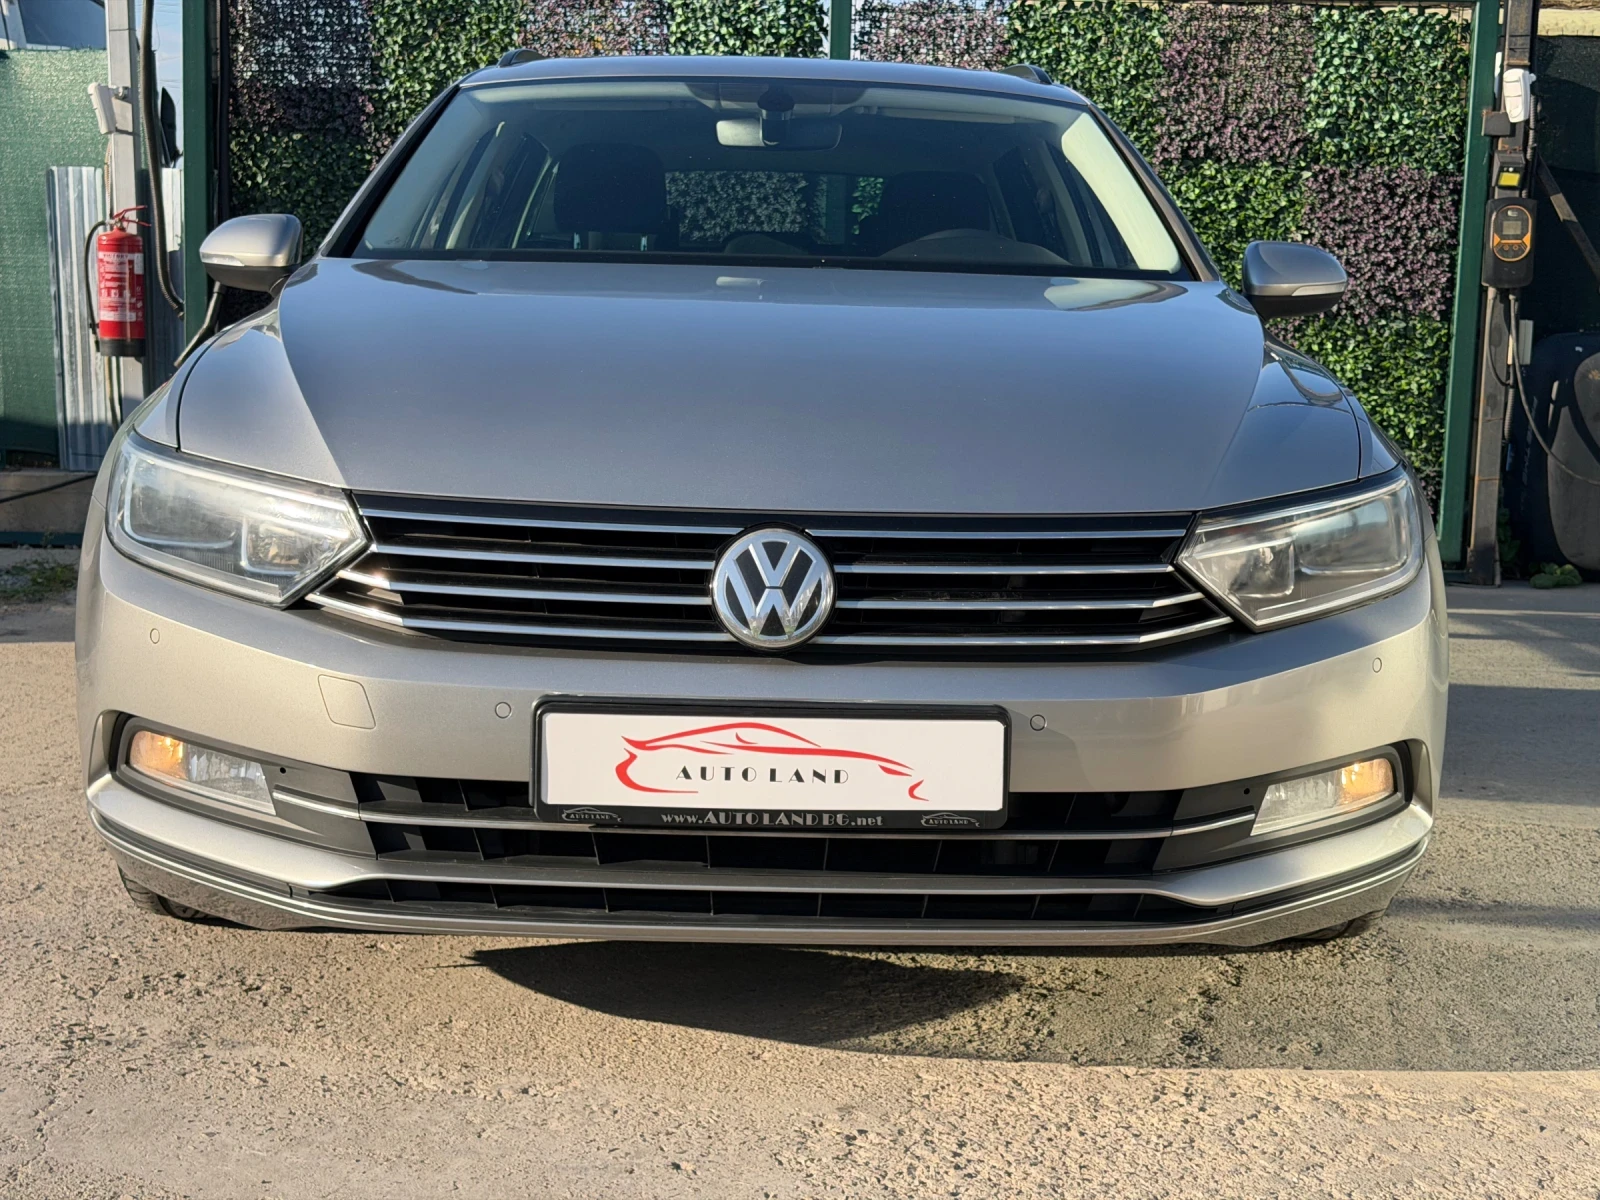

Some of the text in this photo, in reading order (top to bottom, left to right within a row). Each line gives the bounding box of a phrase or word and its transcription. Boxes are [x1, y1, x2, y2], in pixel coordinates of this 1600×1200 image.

[718, 533, 828, 641] VW
[676, 765, 849, 784] AUTO LAND
